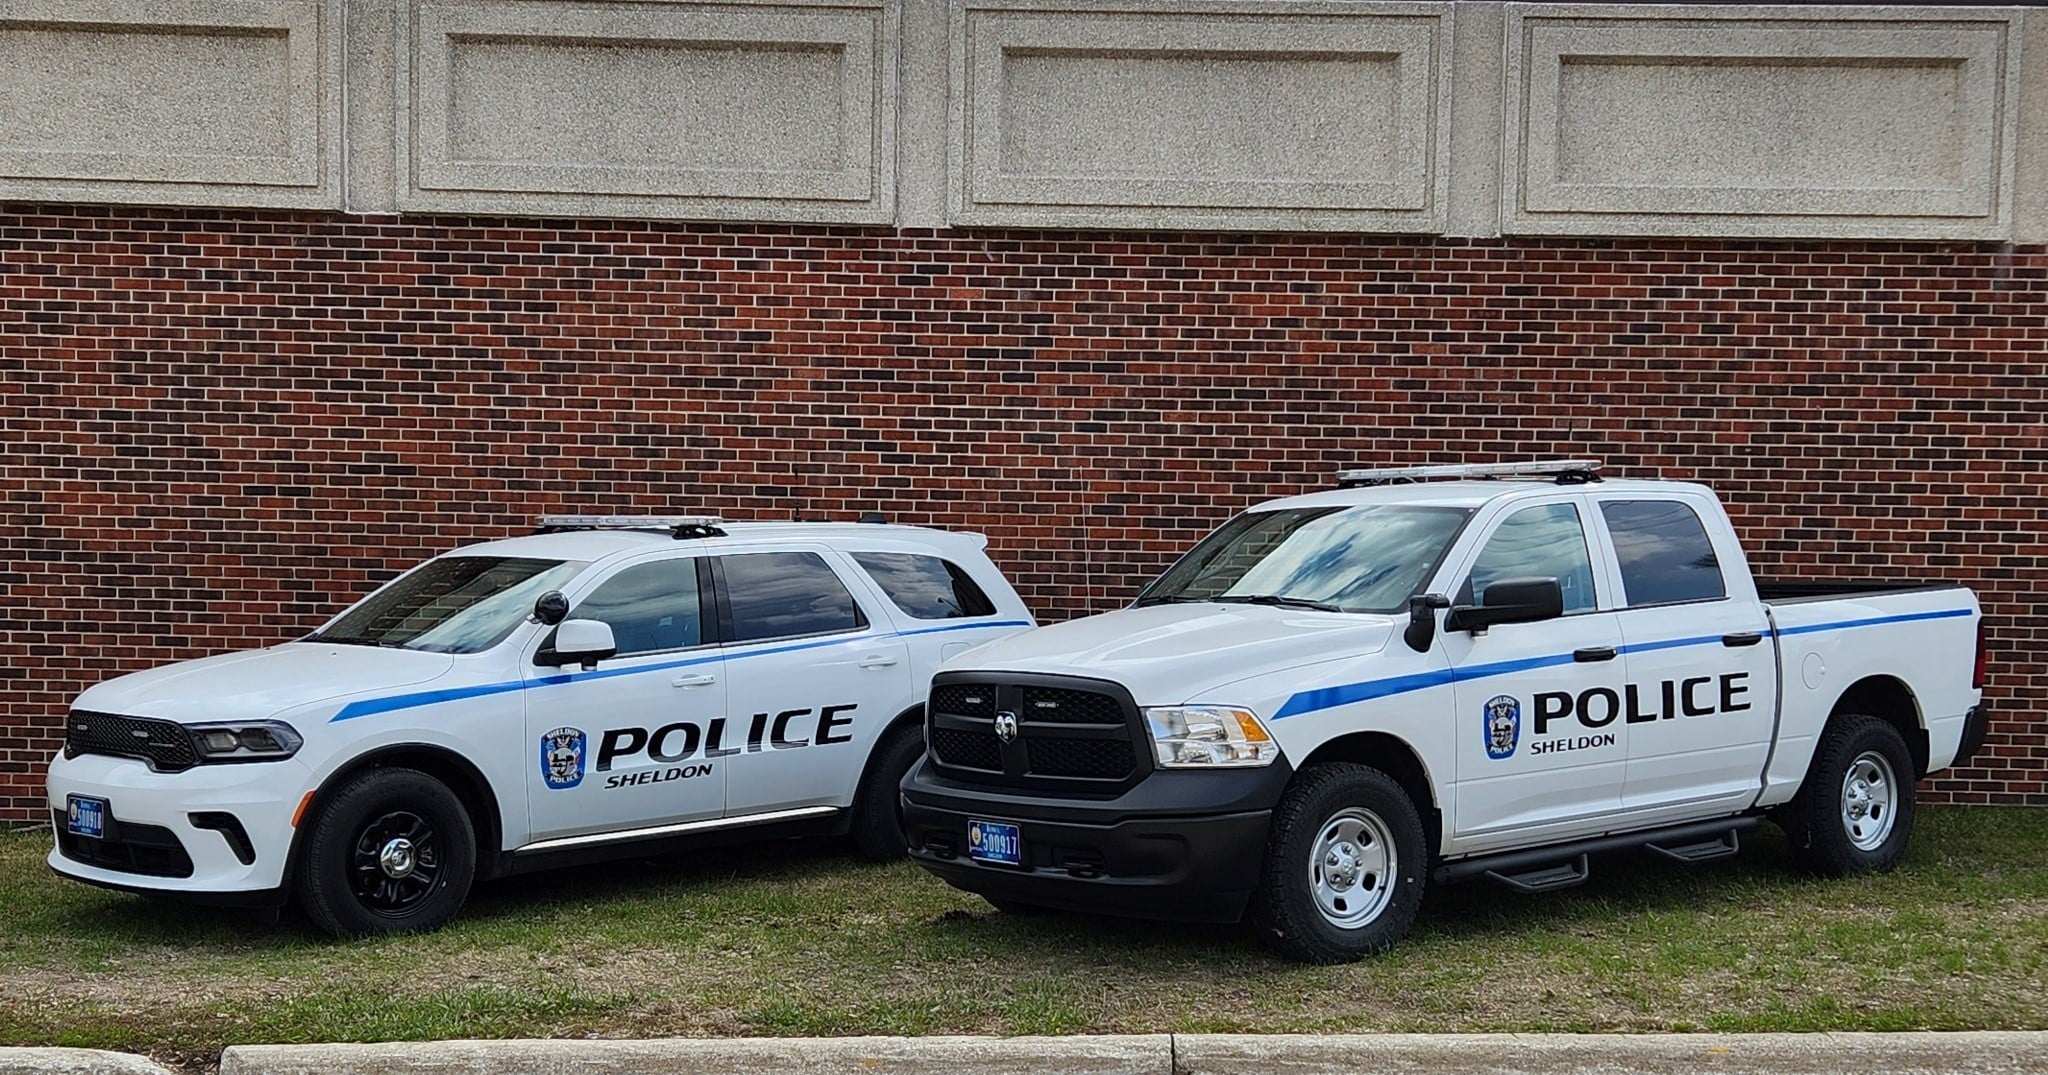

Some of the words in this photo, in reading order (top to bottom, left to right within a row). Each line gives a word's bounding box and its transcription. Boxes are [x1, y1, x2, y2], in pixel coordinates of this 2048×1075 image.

[1532, 672, 1752, 735] POLICE
[596, 703, 858, 772] POLICE
[1530, 733, 1615, 755] SHELDON
[604, 763, 713, 789] SHELDON
[982, 832, 1017, 855] 500917
